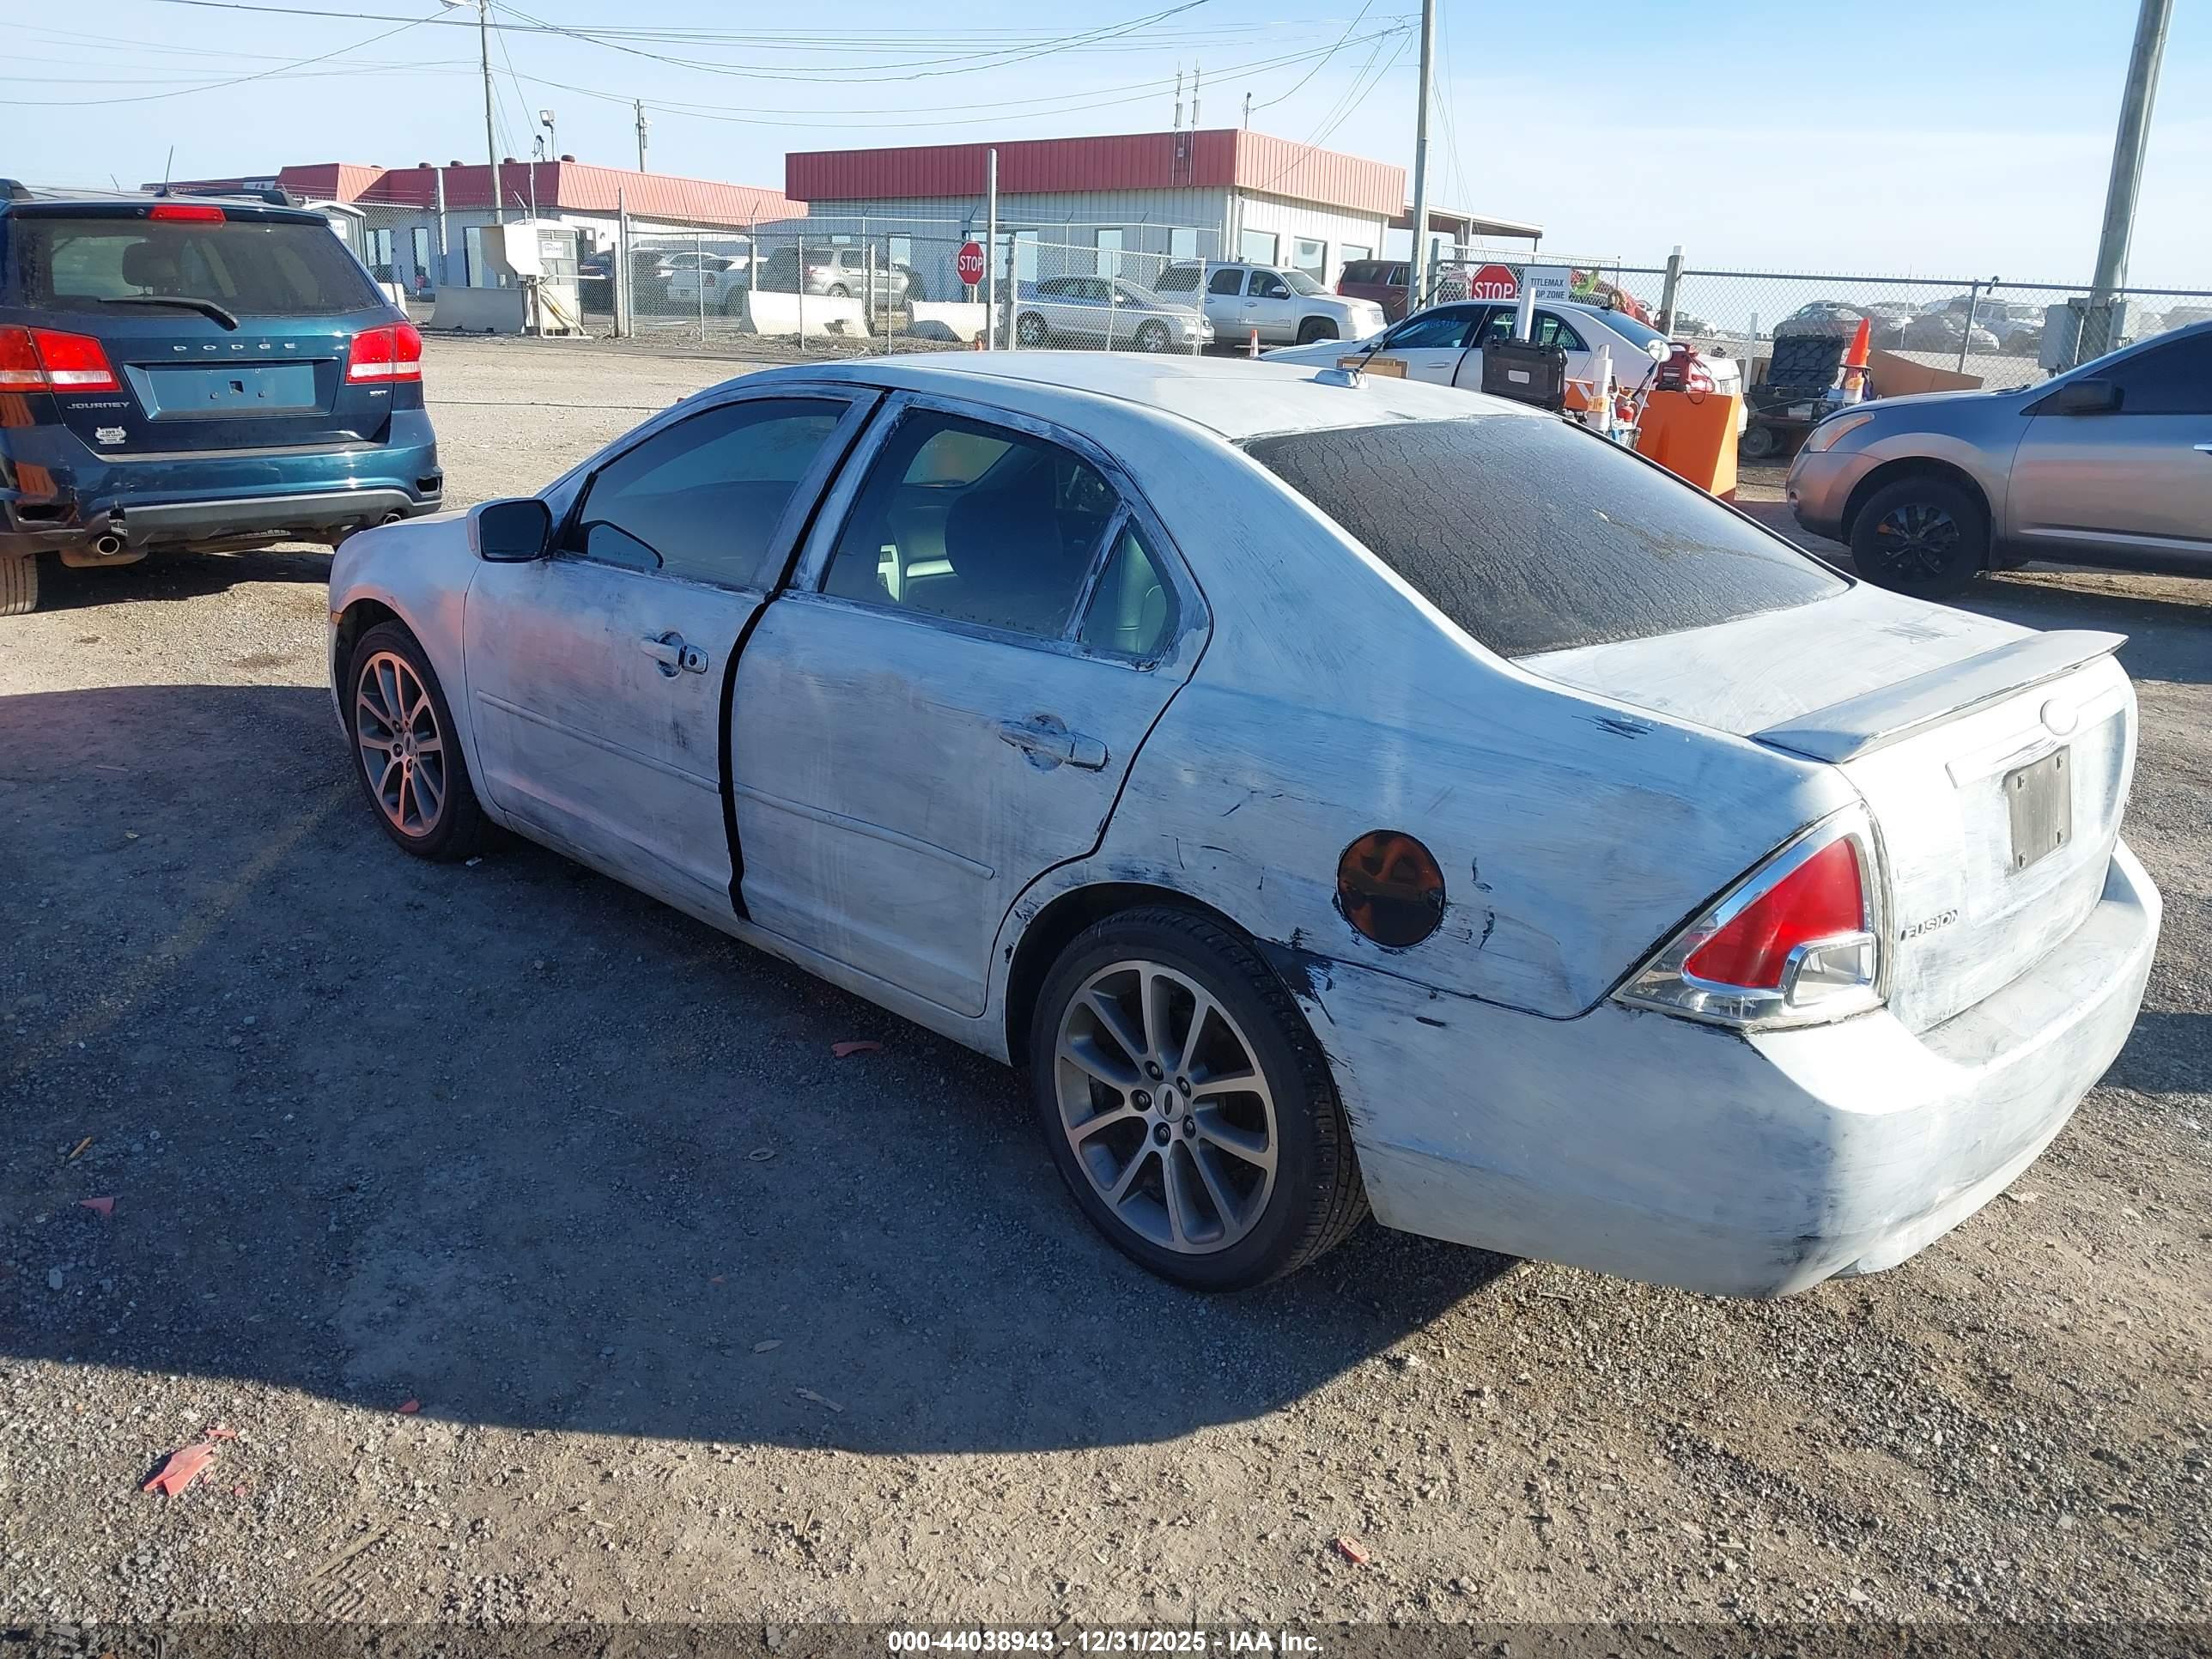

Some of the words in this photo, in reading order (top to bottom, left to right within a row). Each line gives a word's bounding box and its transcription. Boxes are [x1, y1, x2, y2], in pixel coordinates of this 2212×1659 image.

[958, 255, 983, 272] STOP
[1530, 277, 1564, 288] TITLEMAX
[1474, 281, 1514, 300] STOP
[1546, 290, 1565, 299] ZONE
[173, 343, 296, 351] DODGE
[66, 401, 130, 410] JOURNEY
